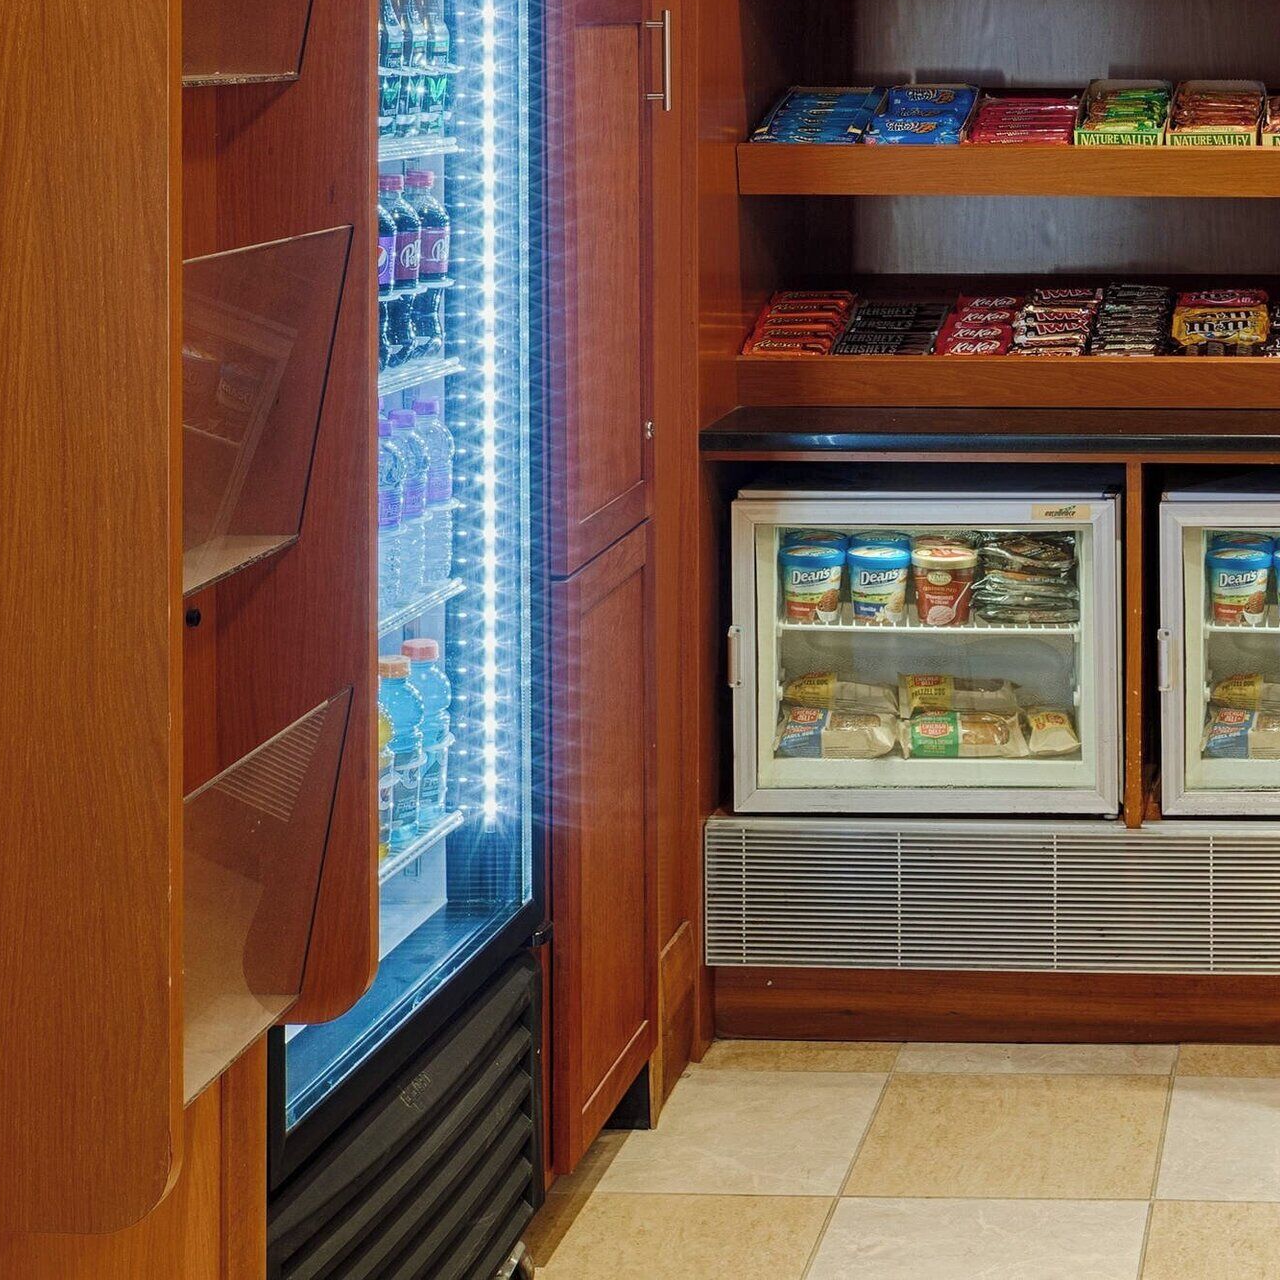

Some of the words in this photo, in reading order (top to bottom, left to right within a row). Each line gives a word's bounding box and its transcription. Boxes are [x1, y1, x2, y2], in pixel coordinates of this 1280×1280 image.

[1080, 133, 1120, 146] NATURE
[1121, 133, 1157, 146] VALLEY
[1173, 135, 1213, 147] NATURE
[1213, 135, 1249, 147] VALLEY
[792, 566, 832, 585] Dean's
[860, 568, 901, 586] Dean's
[1219, 568, 1259, 588] Dean's
